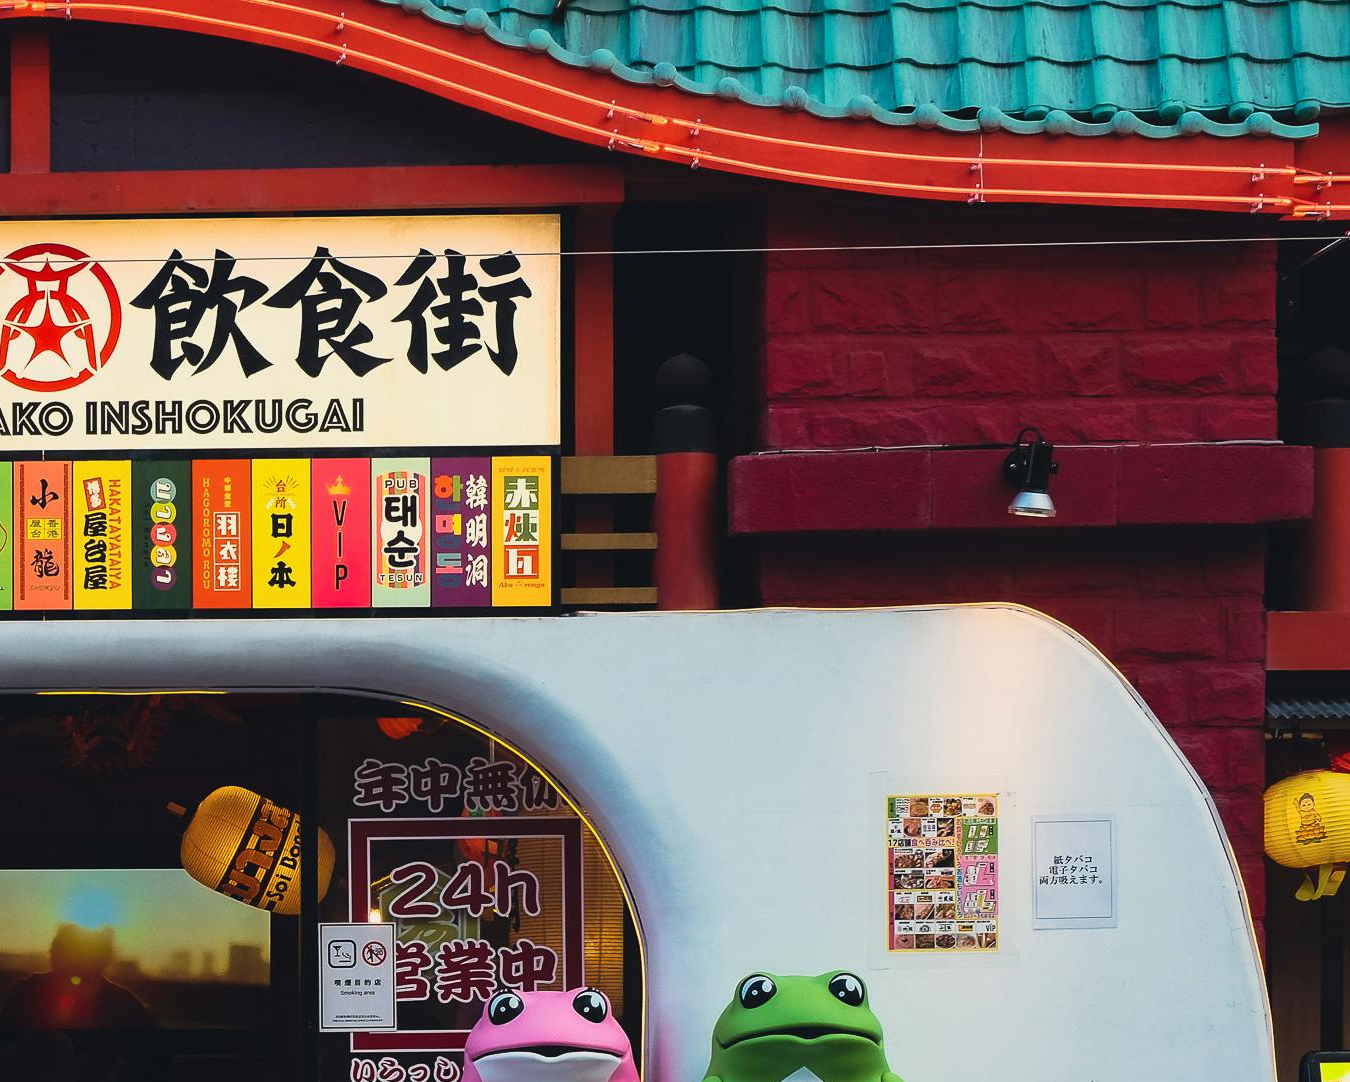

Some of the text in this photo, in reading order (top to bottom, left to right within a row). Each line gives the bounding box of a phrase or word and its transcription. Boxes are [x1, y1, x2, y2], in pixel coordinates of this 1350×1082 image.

[130, 246, 530, 388] 飲食街
[84, 397, 365, 437] INSHOKUGAI
[275, 479, 288, 509] 台所
[384, 479, 418, 489] PUB
[83, 511, 108, 590] 屋台屋
[108, 479, 122, 590] HAKATAYATAIYA
[267, 512, 297, 589] 日ノ本
[332, 500, 348, 590] VIP
[383, 494, 419, 568] 태순
[465, 474, 488, 588] 韓明洞
[379, 574, 423, 582] TESUN
[388, 860, 541, 919] 24h
[1039, 875, 1103, 885] 両方吸えます。
[1049, 865, 1098, 875] 電子タバコ
[1053, 855, 1093, 865] 紙タバコ
[334, 979, 382, 987] 喫煙目的店
[395, 938, 558, 1004] 営業中
